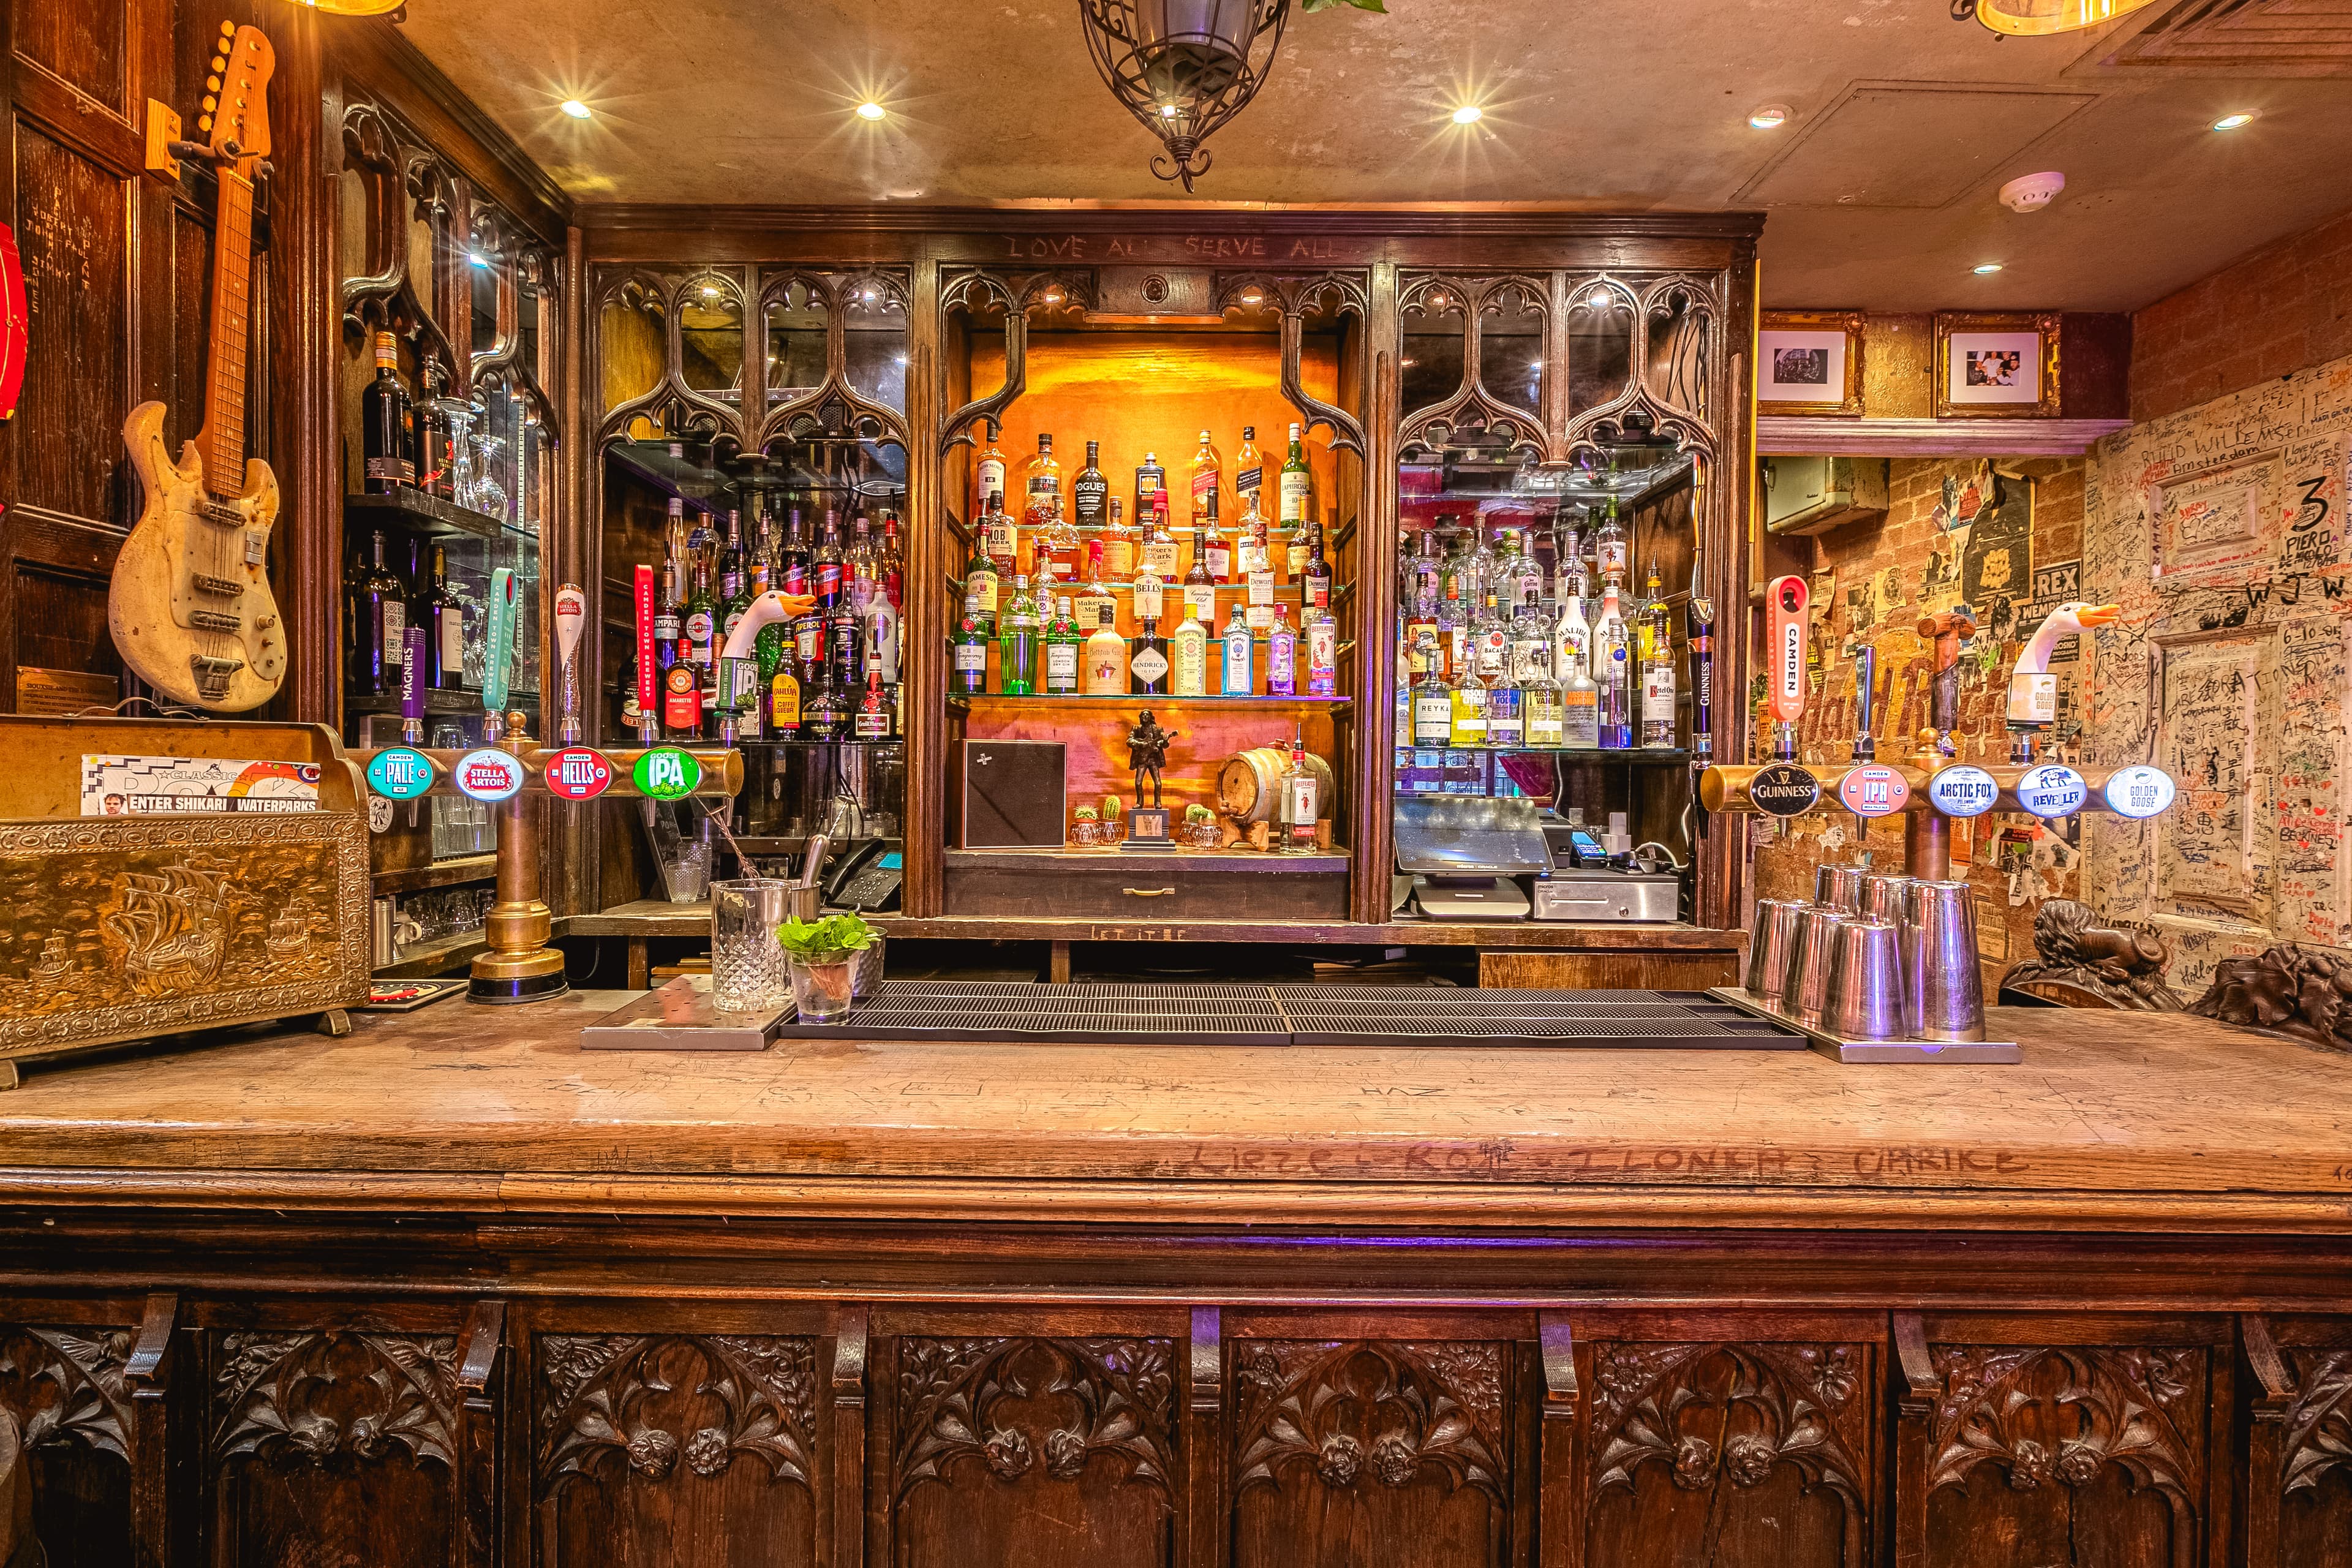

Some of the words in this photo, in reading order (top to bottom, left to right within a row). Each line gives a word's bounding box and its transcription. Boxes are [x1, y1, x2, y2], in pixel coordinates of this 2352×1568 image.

[1001, 235, 1087, 258] LOVE
[1184, 235, 1265, 257] SERVE
[1074, 481, 1106, 492] POGUES
[2286, 529, 2330, 554] PIERO
[968, 574, 997, 583] JAMESON
[1136, 584, 1161, 594] BELL'S
[654, 618, 680, 628] AMPARI
[796, 620, 821, 632] APEROL
[1558, 627, 1589, 641] MALIBU
[957, 652, 983, 660] Tanqueray
[1089, 646, 1111, 657] Bathtub
[1112, 647, 1122, 657] Gin
[402, 647, 413, 701] MAGNERS
[487, 653, 496, 696] BREWERY
[1700, 662, 1710, 706] GUINNESS
[1649, 685, 1667, 697] Ketel
[2036, 701, 2054, 710] GOOSE
[167, 770, 238, 781] CLASSIC
[386, 762, 414, 784] PALE
[470, 767, 505, 778] STELLA
[561, 762, 595, 785] HELLS
[648, 758, 686, 788] IPA
[470, 778, 506, 786] ARTOIS
[1757, 785, 1811, 798] GUINNESS
[1864, 782, 1888, 802] IPA
[1940, 783, 1973, 797] ARCTIC
[1975, 783, 1992, 798] FOX
[2130, 786, 2158, 796] GOLDEN
[129, 796, 173, 810] ENTER
[176, 797, 227, 811] SHIKARI
[237, 798, 316, 812] WATERPARKS
[2034, 791, 2079, 807] REVELLER
[2131, 797, 2155, 808] GOOSE
[2252, 840, 2271, 851] 2022
[1091, 925, 1125, 940] LET
